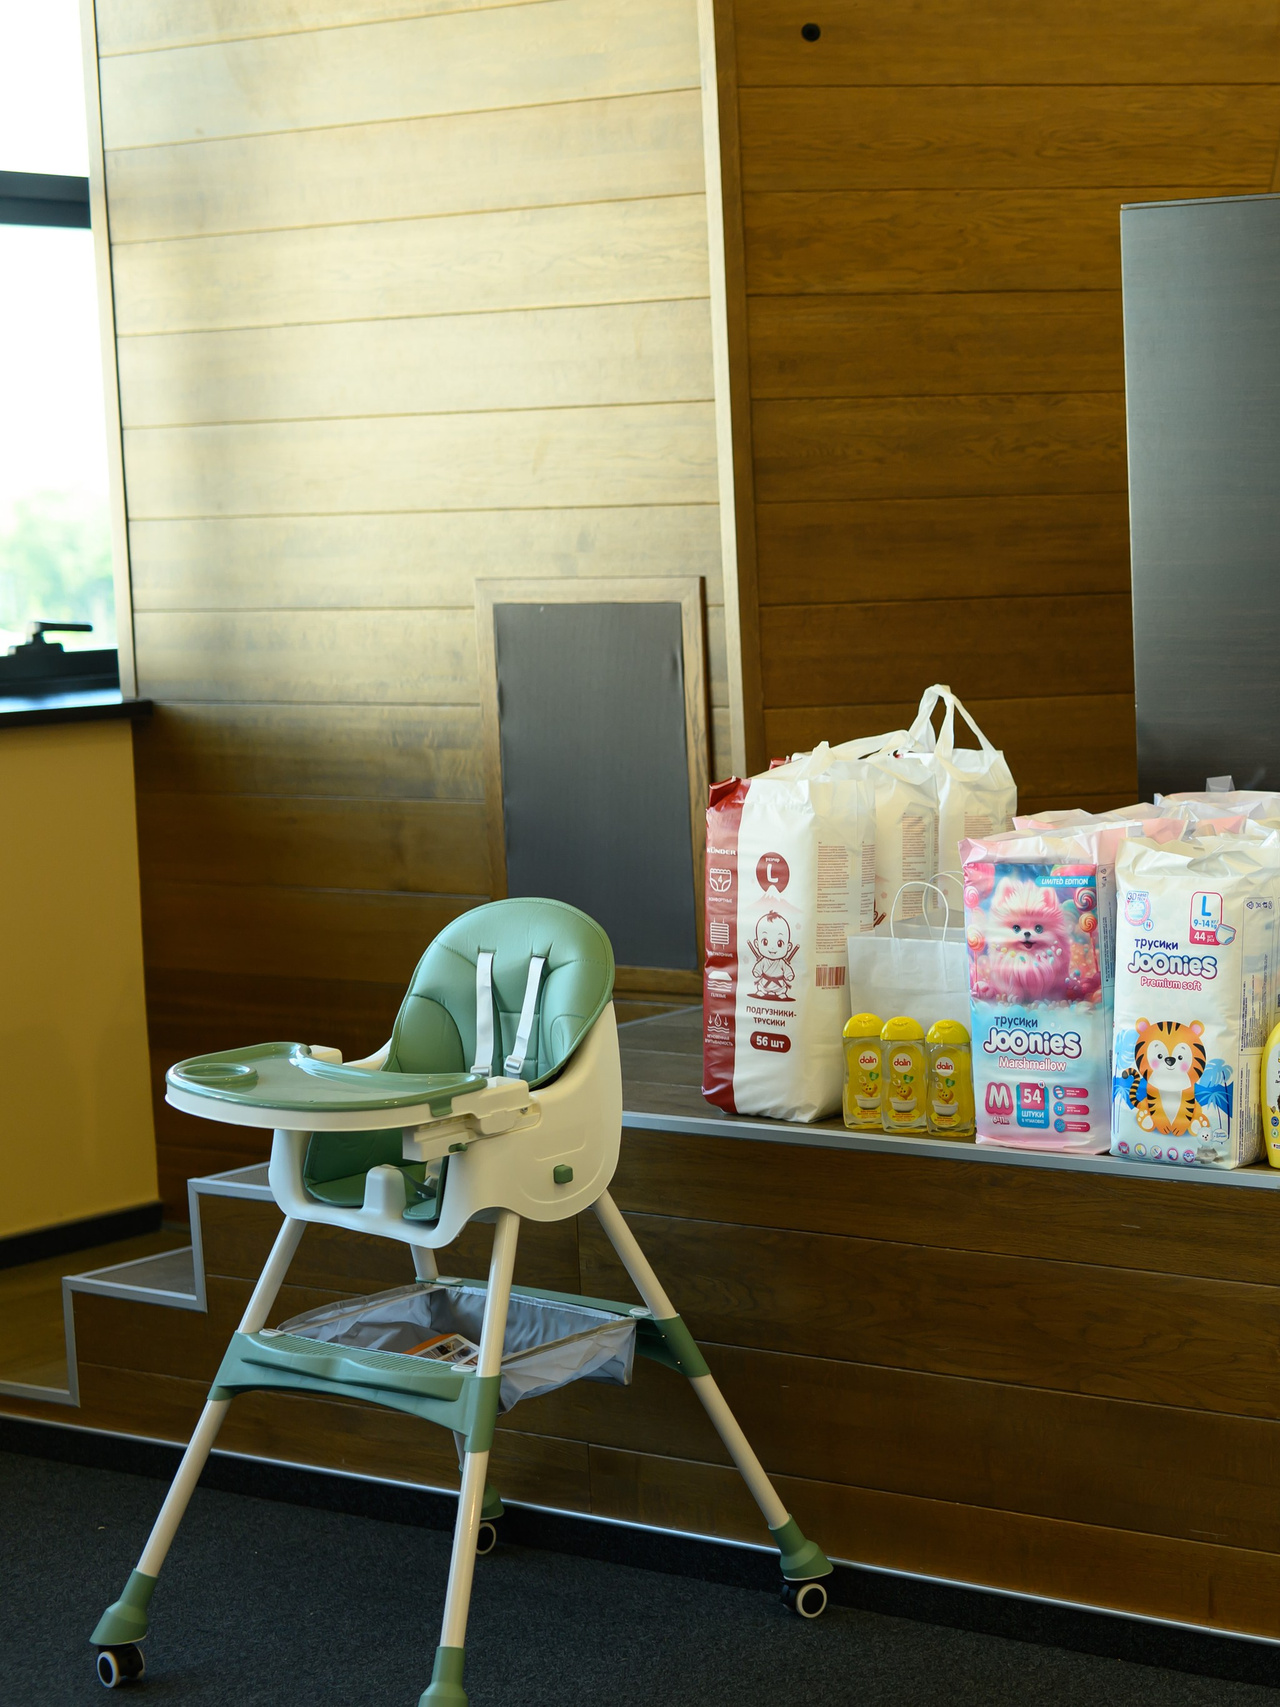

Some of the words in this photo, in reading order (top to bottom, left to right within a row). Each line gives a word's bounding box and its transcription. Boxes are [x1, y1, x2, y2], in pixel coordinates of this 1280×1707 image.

[767, 863, 779, 883] L
[1041, 878, 1064, 886] LIMITED
[1065, 878, 1089, 886] EDITION
[1201, 895, 1212, 917] L
[1193, 919, 1210, 929] 9-14
[1194, 931, 1206, 941] 44
[1135, 938, 1179, 951] трусики
[1141, 976, 1182, 990] Premium
[1182, 980, 1203, 991] soft
[746, 1005, 797, 1018] ПОДГУЗНИКИ-
[753, 1016, 786, 1027] ТРУСИКИ
[994, 1016, 1038, 1028] трусики
[756, 1035, 768, 1046] 56
[770, 1038, 785, 1049] шт
[859, 1056, 877, 1064] dalin
[893, 1058, 912, 1067] dalin
[936, 1061, 954, 1071] dalin
[998, 1055, 1067, 1071] Marshmallow
[988, 1084, 1010, 1109] M
[1022, 1088, 1042, 1104] 54
[1021, 1110, 1045, 1119] ШТУКИ
